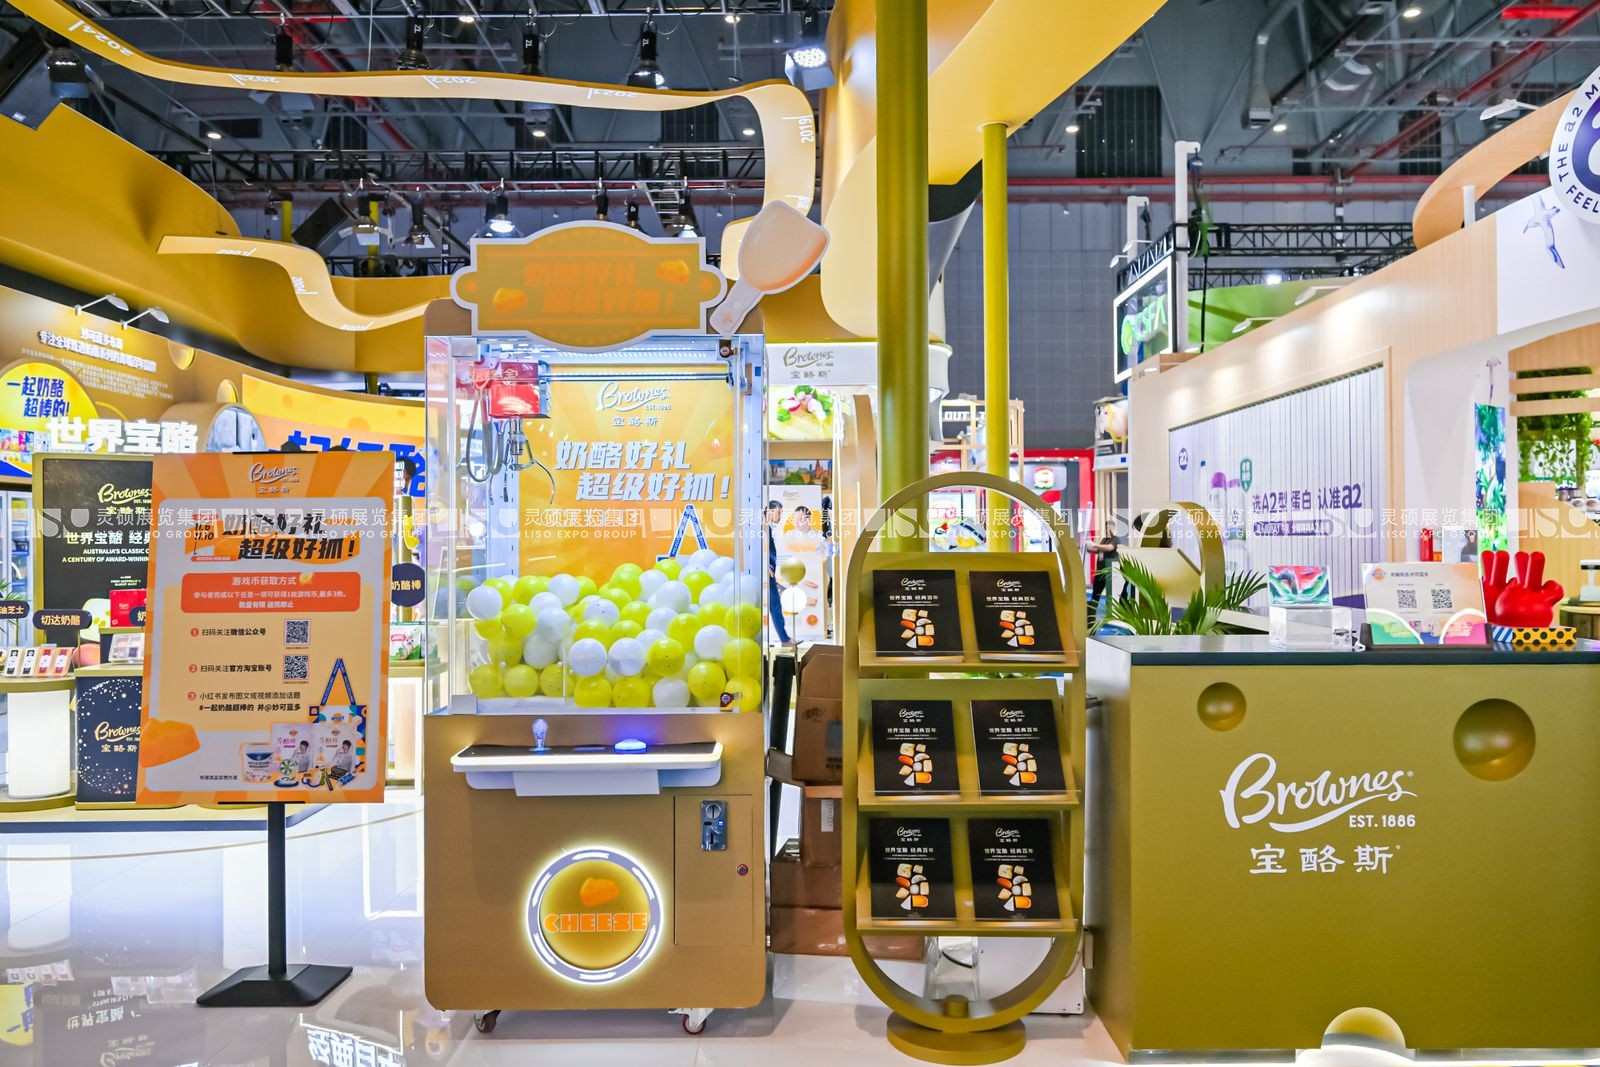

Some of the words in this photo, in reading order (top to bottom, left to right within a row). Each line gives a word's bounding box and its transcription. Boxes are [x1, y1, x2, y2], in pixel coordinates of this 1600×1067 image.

[83, 24, 134, 57] 2024
[799, 117, 814, 144] 2019
[1557, 142, 1569, 183] THE
[1564, 106, 1584, 132] a2
[783, 347, 835, 368] Brownes
[7, 376, 65, 397] 一起奶酪
[596, 381, 670, 412] Brownes
[46, 417, 199, 453] 世界宝酪
[554, 441, 692, 470] 奶酪好礼
[249, 462, 298, 484] Brownes
[97, 483, 152, 505] Brownes
[65, 532, 123, 546] 世界宝酪
[232, 576, 297, 586] 游戏币获取方式
[390, 580, 422, 591] 奶酪棒
[40, 614, 81, 626] 切达奶酪
[201, 628, 266, 636] 扫码关注微信公众号
[200, 664, 272, 673] 扫码关注官方淘宝账号
[199, 691, 301, 700] 小红书发布图文或视频添加话题
[94, 721, 140, 743] Brownes
[1219, 753, 1418, 833] Brownes
[1349, 814, 1378, 828] EST.
[1381, 814, 1416, 828] 1886
[1249, 843, 1394, 874] 宝酪斯
[542, 912, 648, 933] CHEESE
